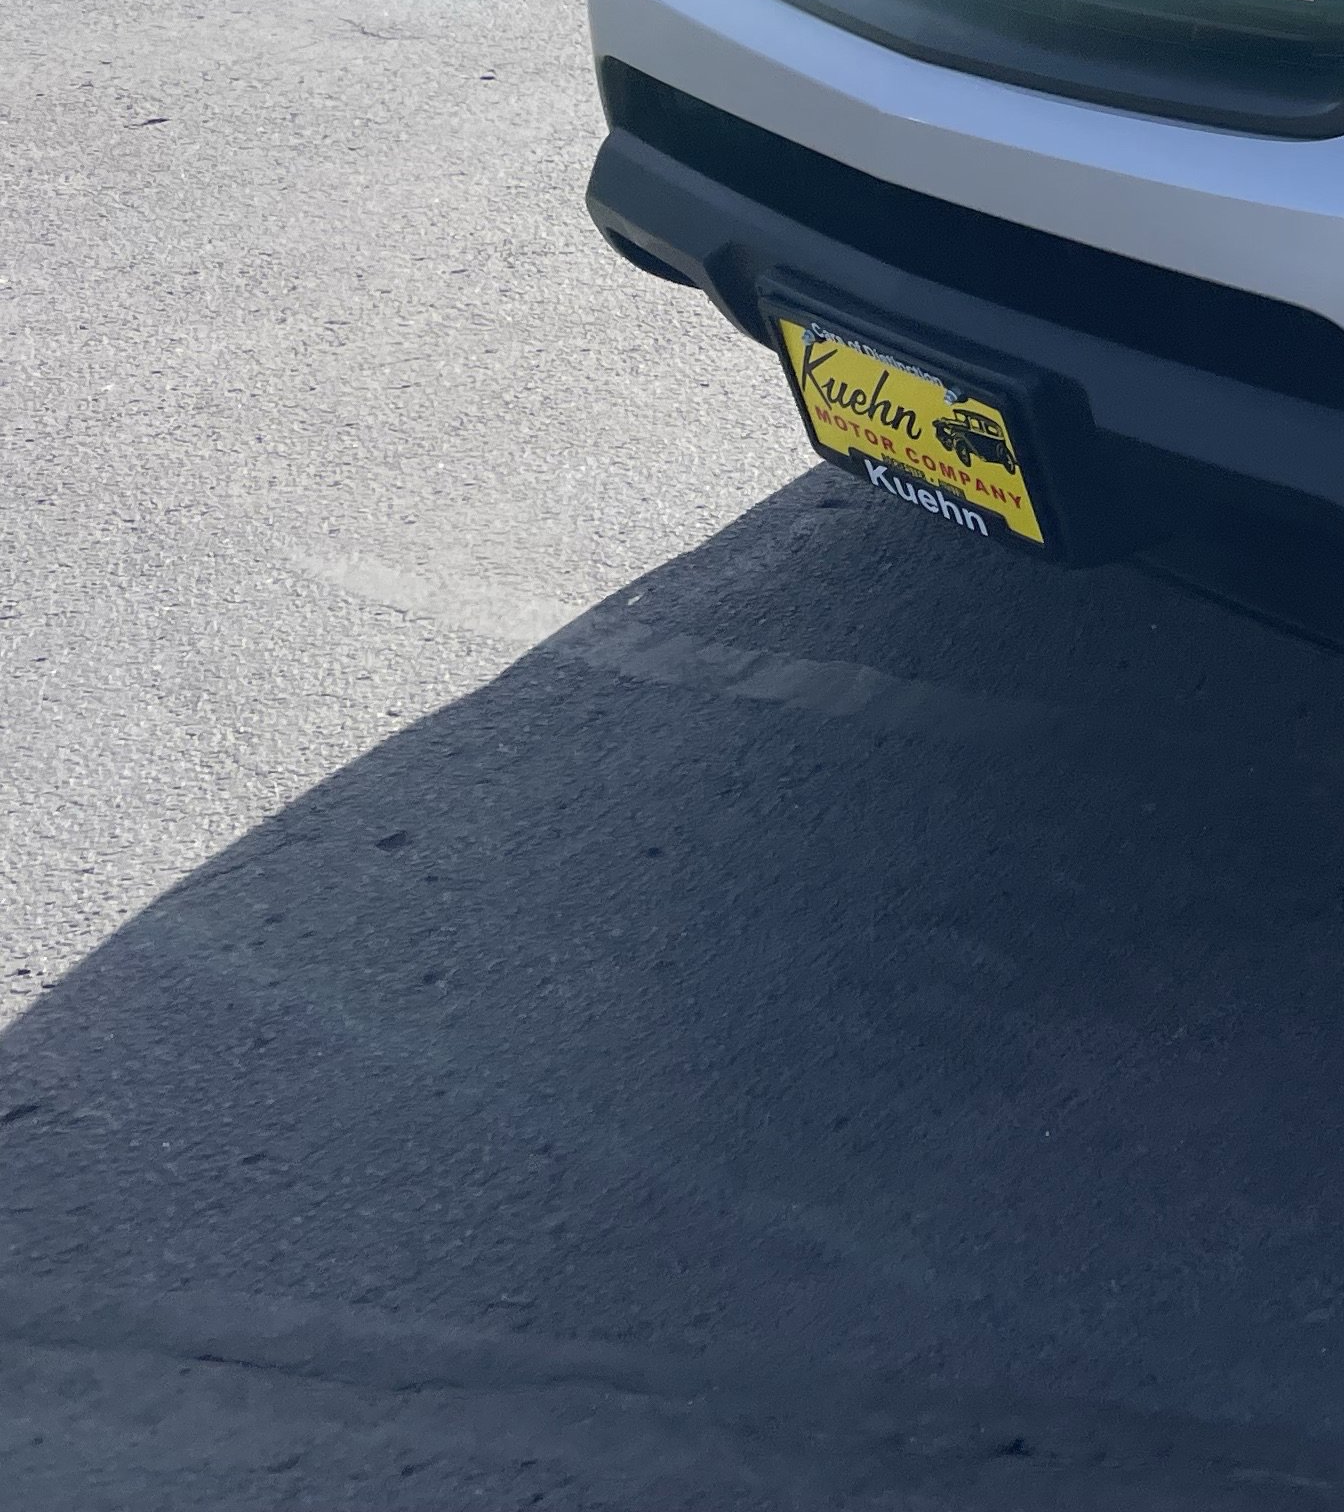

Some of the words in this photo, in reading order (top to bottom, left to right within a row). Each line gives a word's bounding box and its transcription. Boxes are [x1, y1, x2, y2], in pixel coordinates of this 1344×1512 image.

[801, 343, 922, 440] Kuehn
[814, 404, 897, 455] MOTOR
[904, 446, 1022, 510] COMPANY
[863, 458, 989, 538] Kuehn
